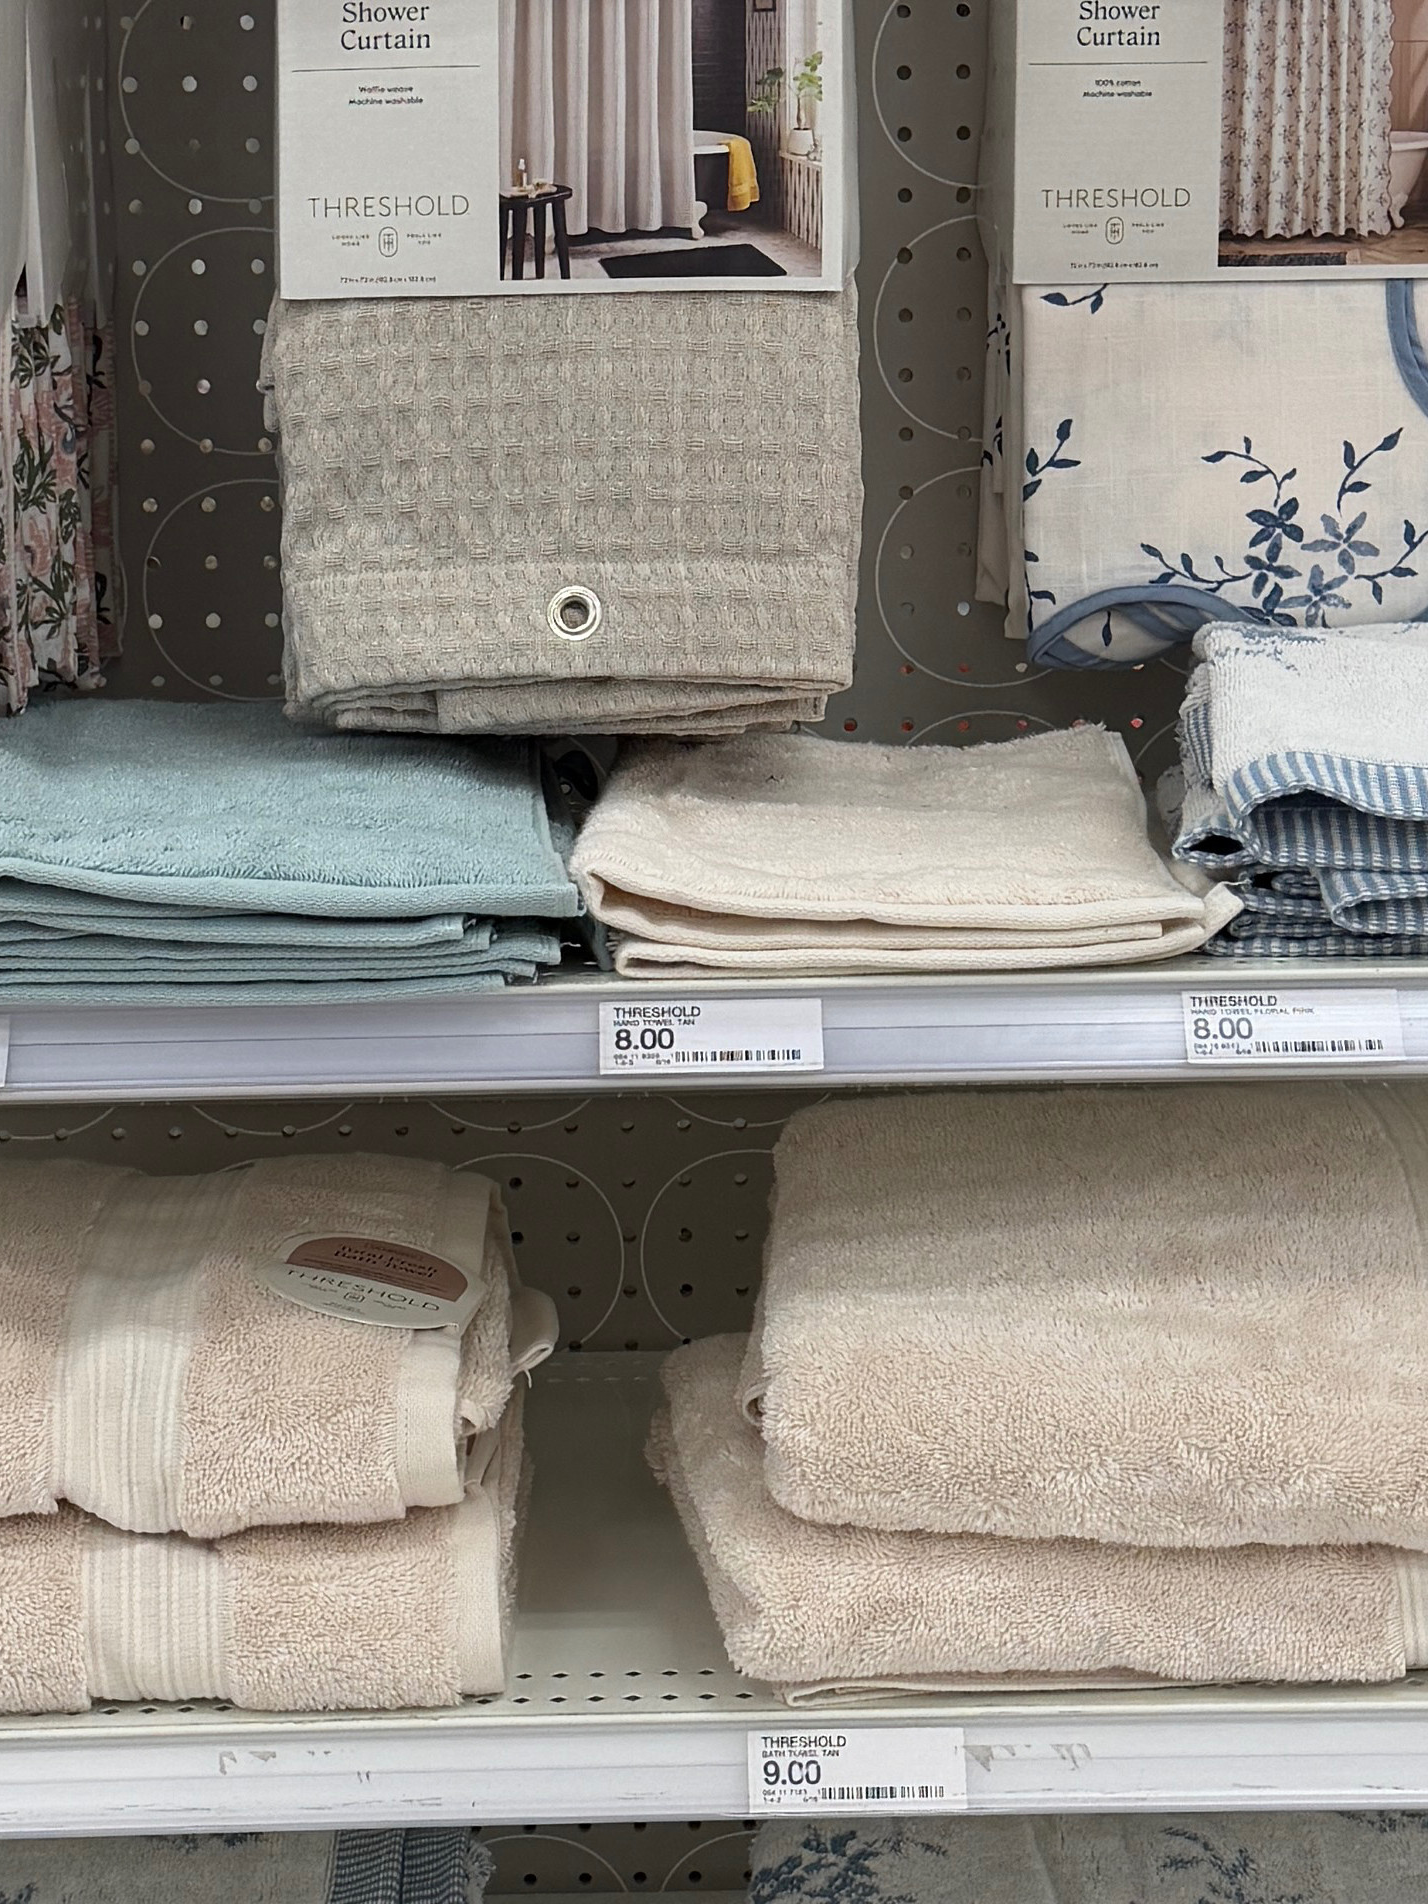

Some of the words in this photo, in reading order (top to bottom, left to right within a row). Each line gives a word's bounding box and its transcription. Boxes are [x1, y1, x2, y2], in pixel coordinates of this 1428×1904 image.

[342, 2, 429, 23] Shower
[1079, 0, 1160, 20] Shower
[341, 29, 431, 50] Curtain
[1077, 26, 1160, 46] Curtain
[308, 195, 470, 218] THRESHOLD
[1041, 188, 1191, 208] THRESHOLD
[1190, 996, 1277, 1007] THRESHOLD
[613, 1006, 700, 1018] THRESHOLD
[1193, 1017, 1253, 1040] 8.00
[615, 1028, 674, 1050] 8.00
[288, 1270, 440, 1311] THRESHOLD
[762, 1735, 847, 1747] THRESHOLD
[822, 1749, 840, 1757] TAN
[763, 1760, 821, 1785] 9.00
